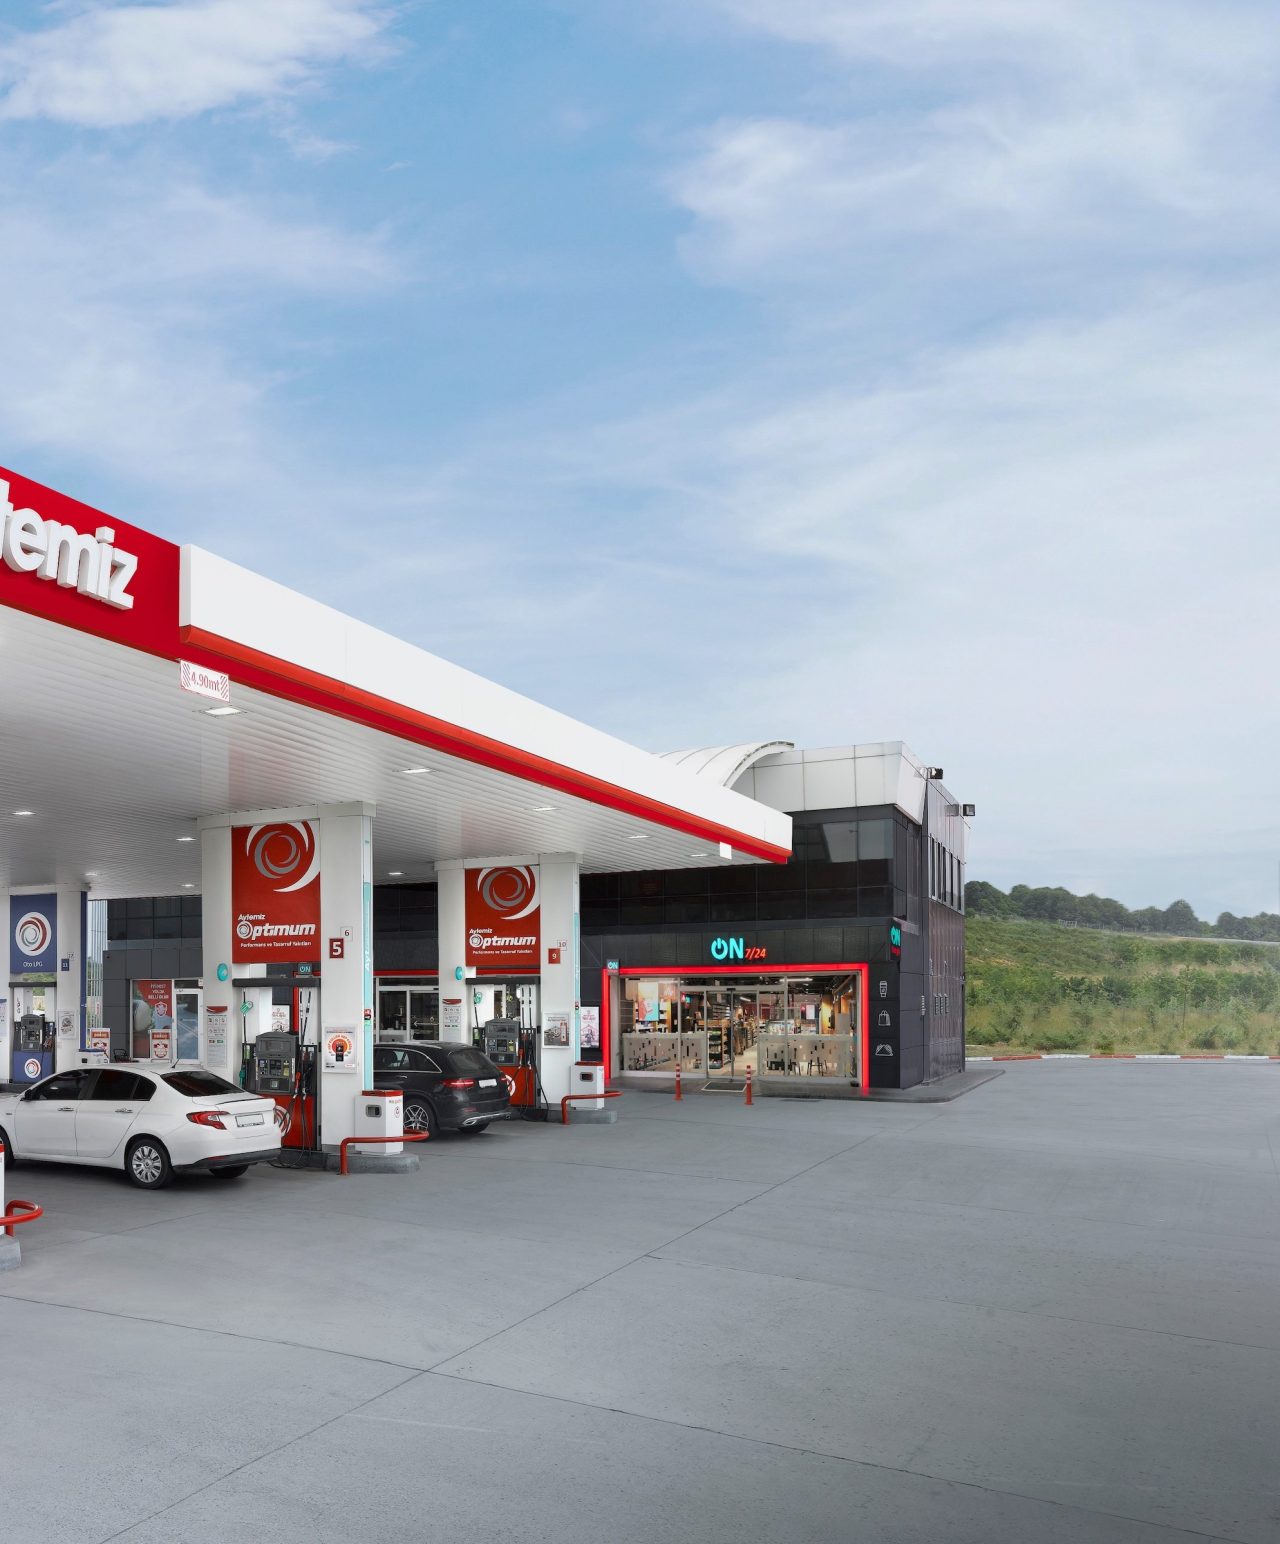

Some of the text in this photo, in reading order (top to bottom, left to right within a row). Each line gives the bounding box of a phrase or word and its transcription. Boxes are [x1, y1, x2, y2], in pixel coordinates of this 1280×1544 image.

[191, 672, 220, 692] 4.90mt
[238, 913, 266, 921] Aytemiz
[344, 929, 350, 937] 6
[890, 925, 901, 946] ON
[332, 941, 342, 956] 5
[710, 937, 767, 960] ON 7/24
[607, 961, 619, 969] ON
